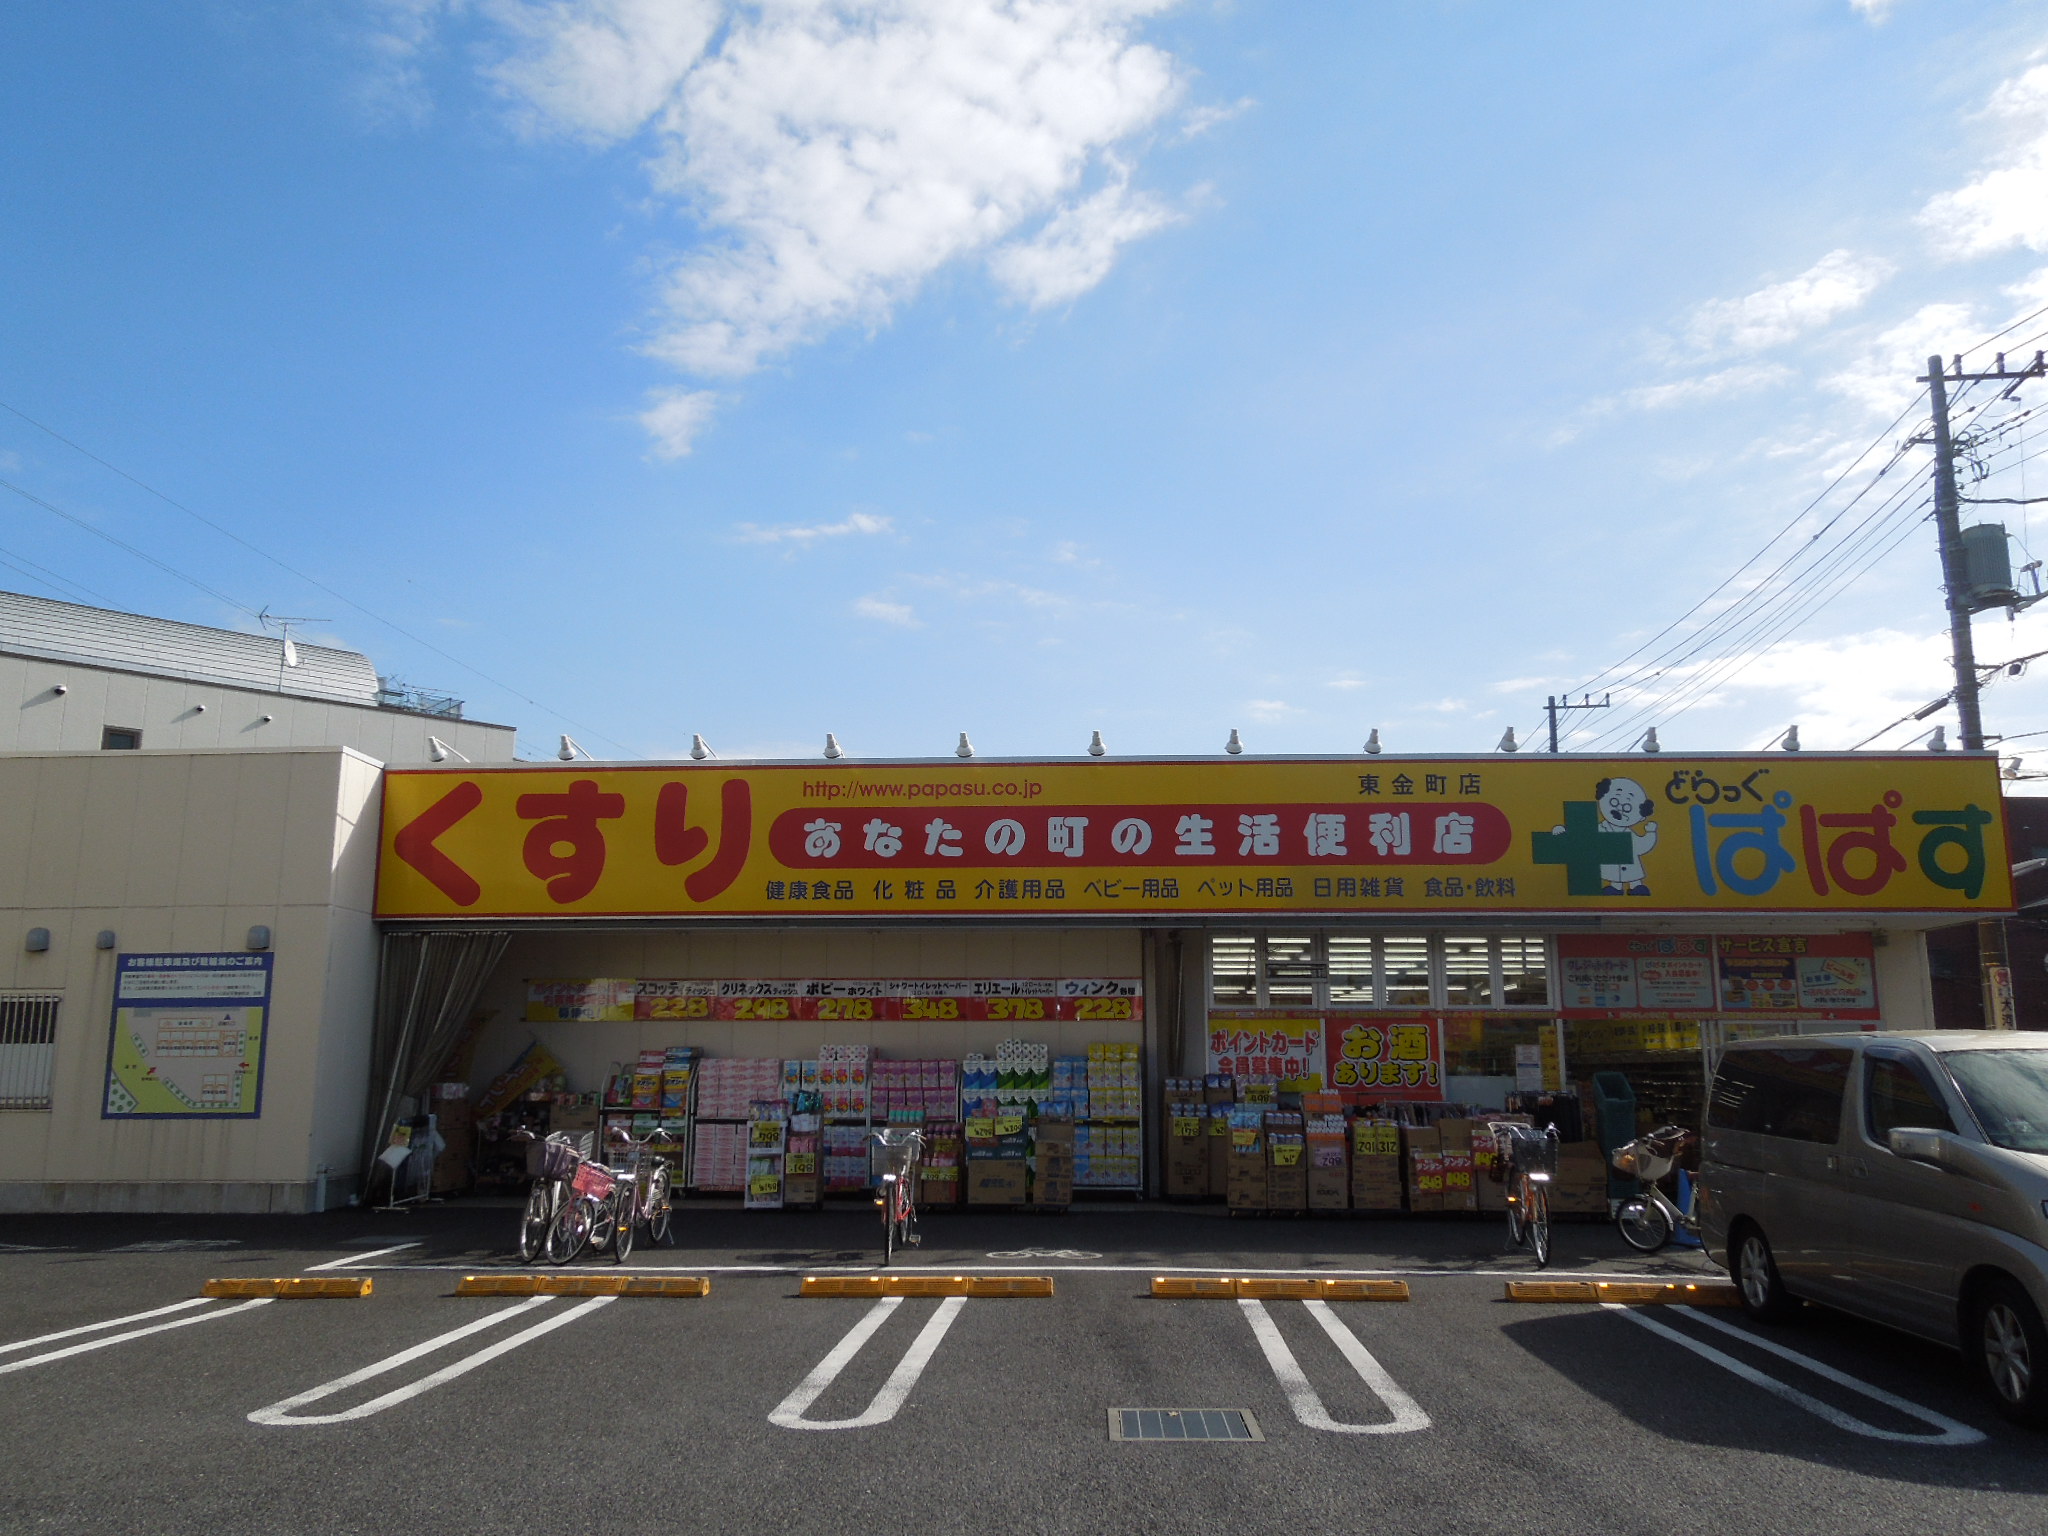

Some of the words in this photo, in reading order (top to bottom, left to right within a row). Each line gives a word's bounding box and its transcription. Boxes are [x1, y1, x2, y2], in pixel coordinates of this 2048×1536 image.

[802, 780, 1042, 800] http://www.papasu.co.jp
[1358, 772, 1482, 796] 東金町店
[1665, 769, 1769, 804] どらっぐ
[394, 779, 752, 907] くすり
[803, 812, 1475, 859] あなたの町の生活便利店
[1688, 790, 1992, 899] ぱぱす
[765, 879, 854, 900] 健康食品
[873, 879, 957, 900] 化粧品
[974, 878, 1066, 900] 介護用品
[1084, 878, 1180, 898] ベビー用品
[1197, 877, 1294, 898] ペット用品
[1313, 877, 1404, 898] 日用雑貨
[1719, 937, 1808, 953] サービス宣言
[722, 983, 771, 996] クリネックス
[889, 982, 968, 991] シャワートイレットペーパー
[974, 982, 1020, 996] エリエール
[1065, 981, 1119, 996] ウィンク
[650, 998, 709, 1019] 228
[734, 998, 791, 1020] 298
[817, 998, 873, 1020] 278
[902, 998, 960, 1020] 348
[987, 998, 1045, 1020] 378
[1074, 998, 1133, 1020] 228
[1210, 1029, 1320, 1056] ポイントカード
[1341, 1024, 1430, 1062] お酒
[1217, 1055, 1310, 1082] 会員募集中!
[1334, 1061, 1440, 1087] あります!
[1378, 1142, 1397, 1153] 312
